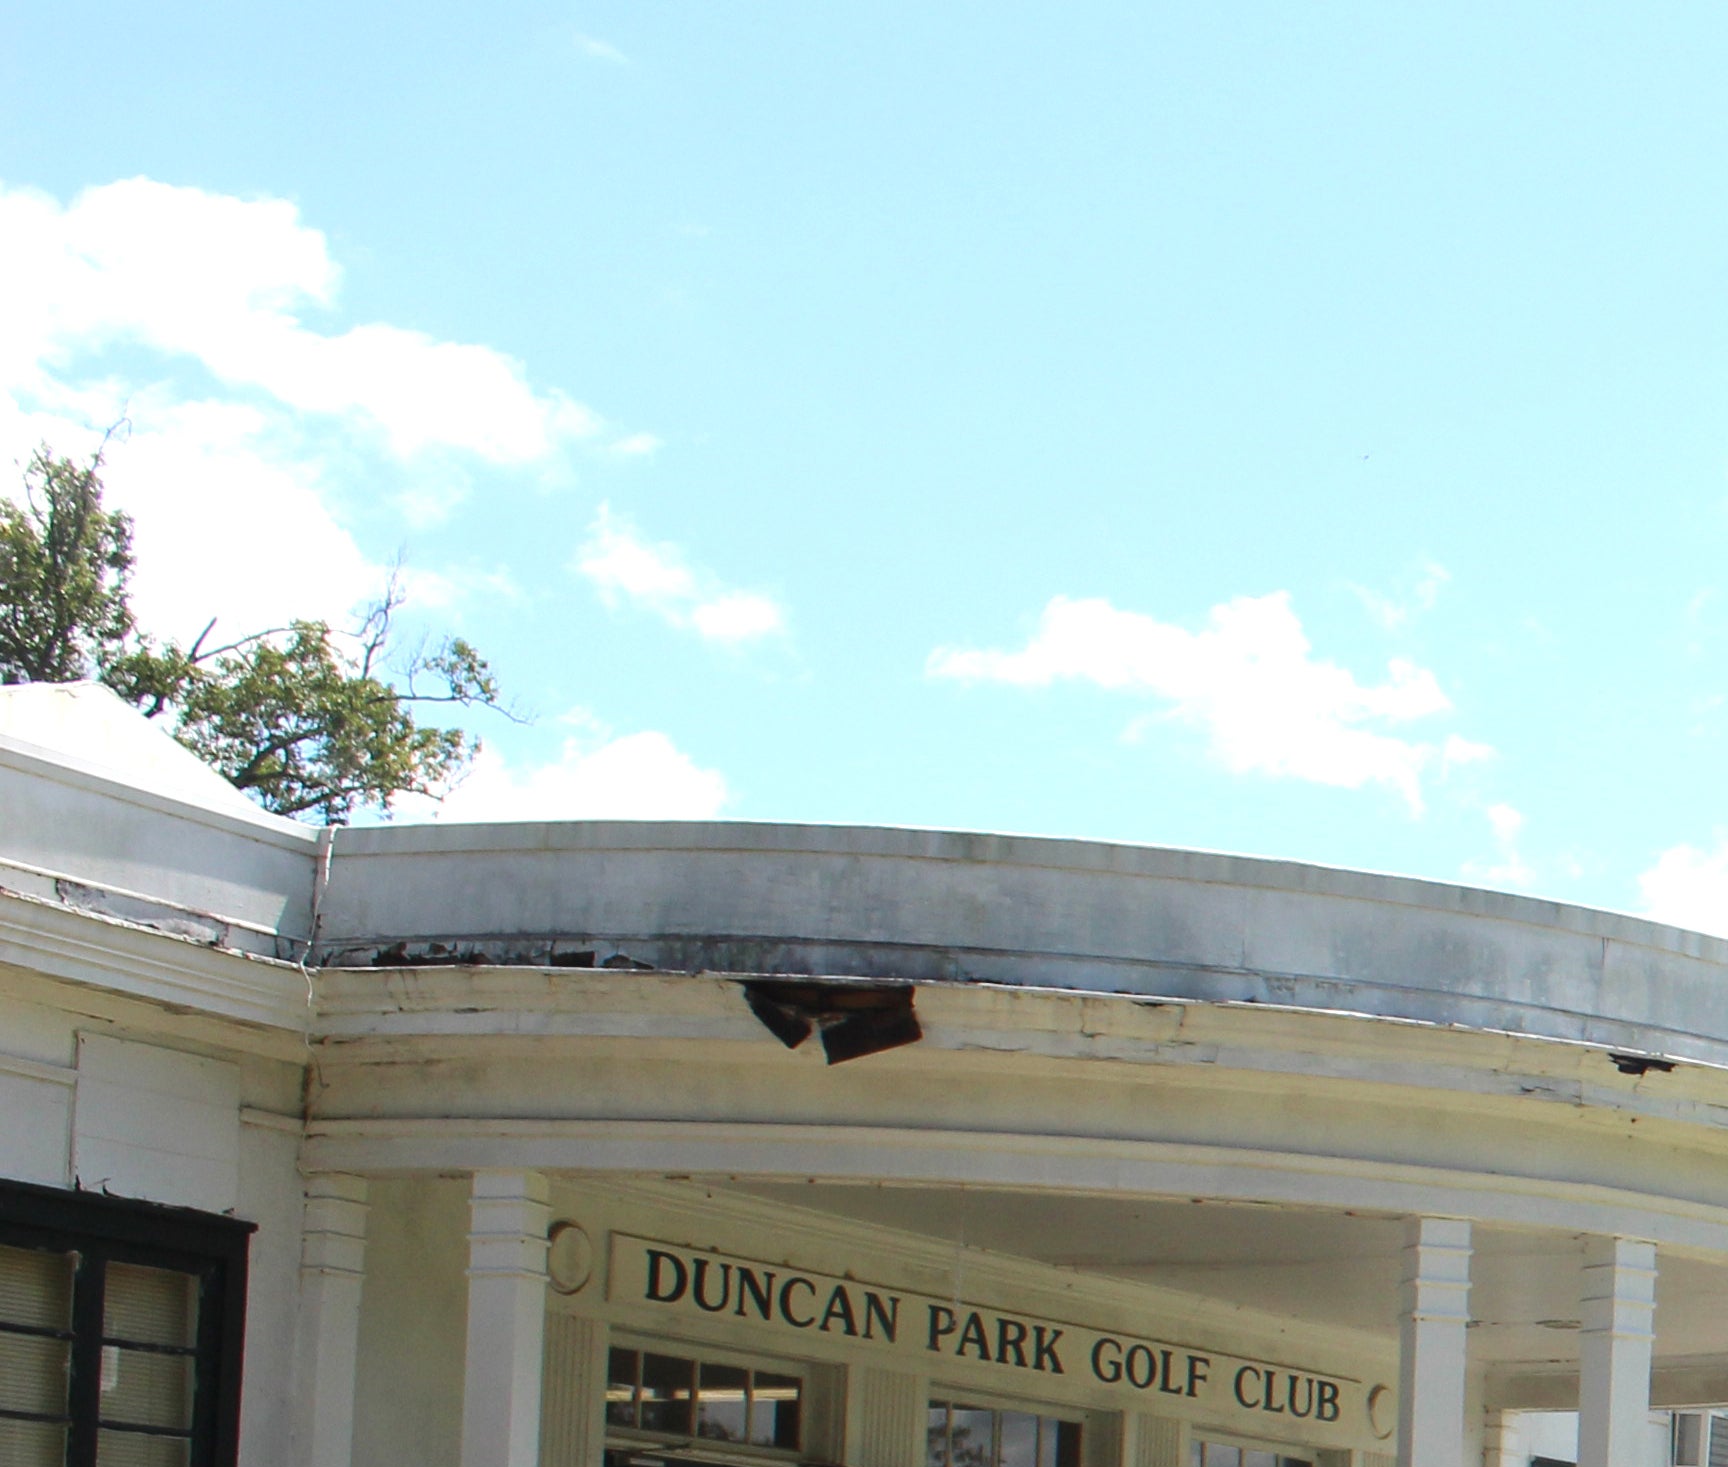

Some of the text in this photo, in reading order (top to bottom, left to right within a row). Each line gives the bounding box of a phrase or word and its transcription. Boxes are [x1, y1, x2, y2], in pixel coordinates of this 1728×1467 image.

[645, 1248, 1341, 1423] DUNCAN PARK GOLF CLUB
